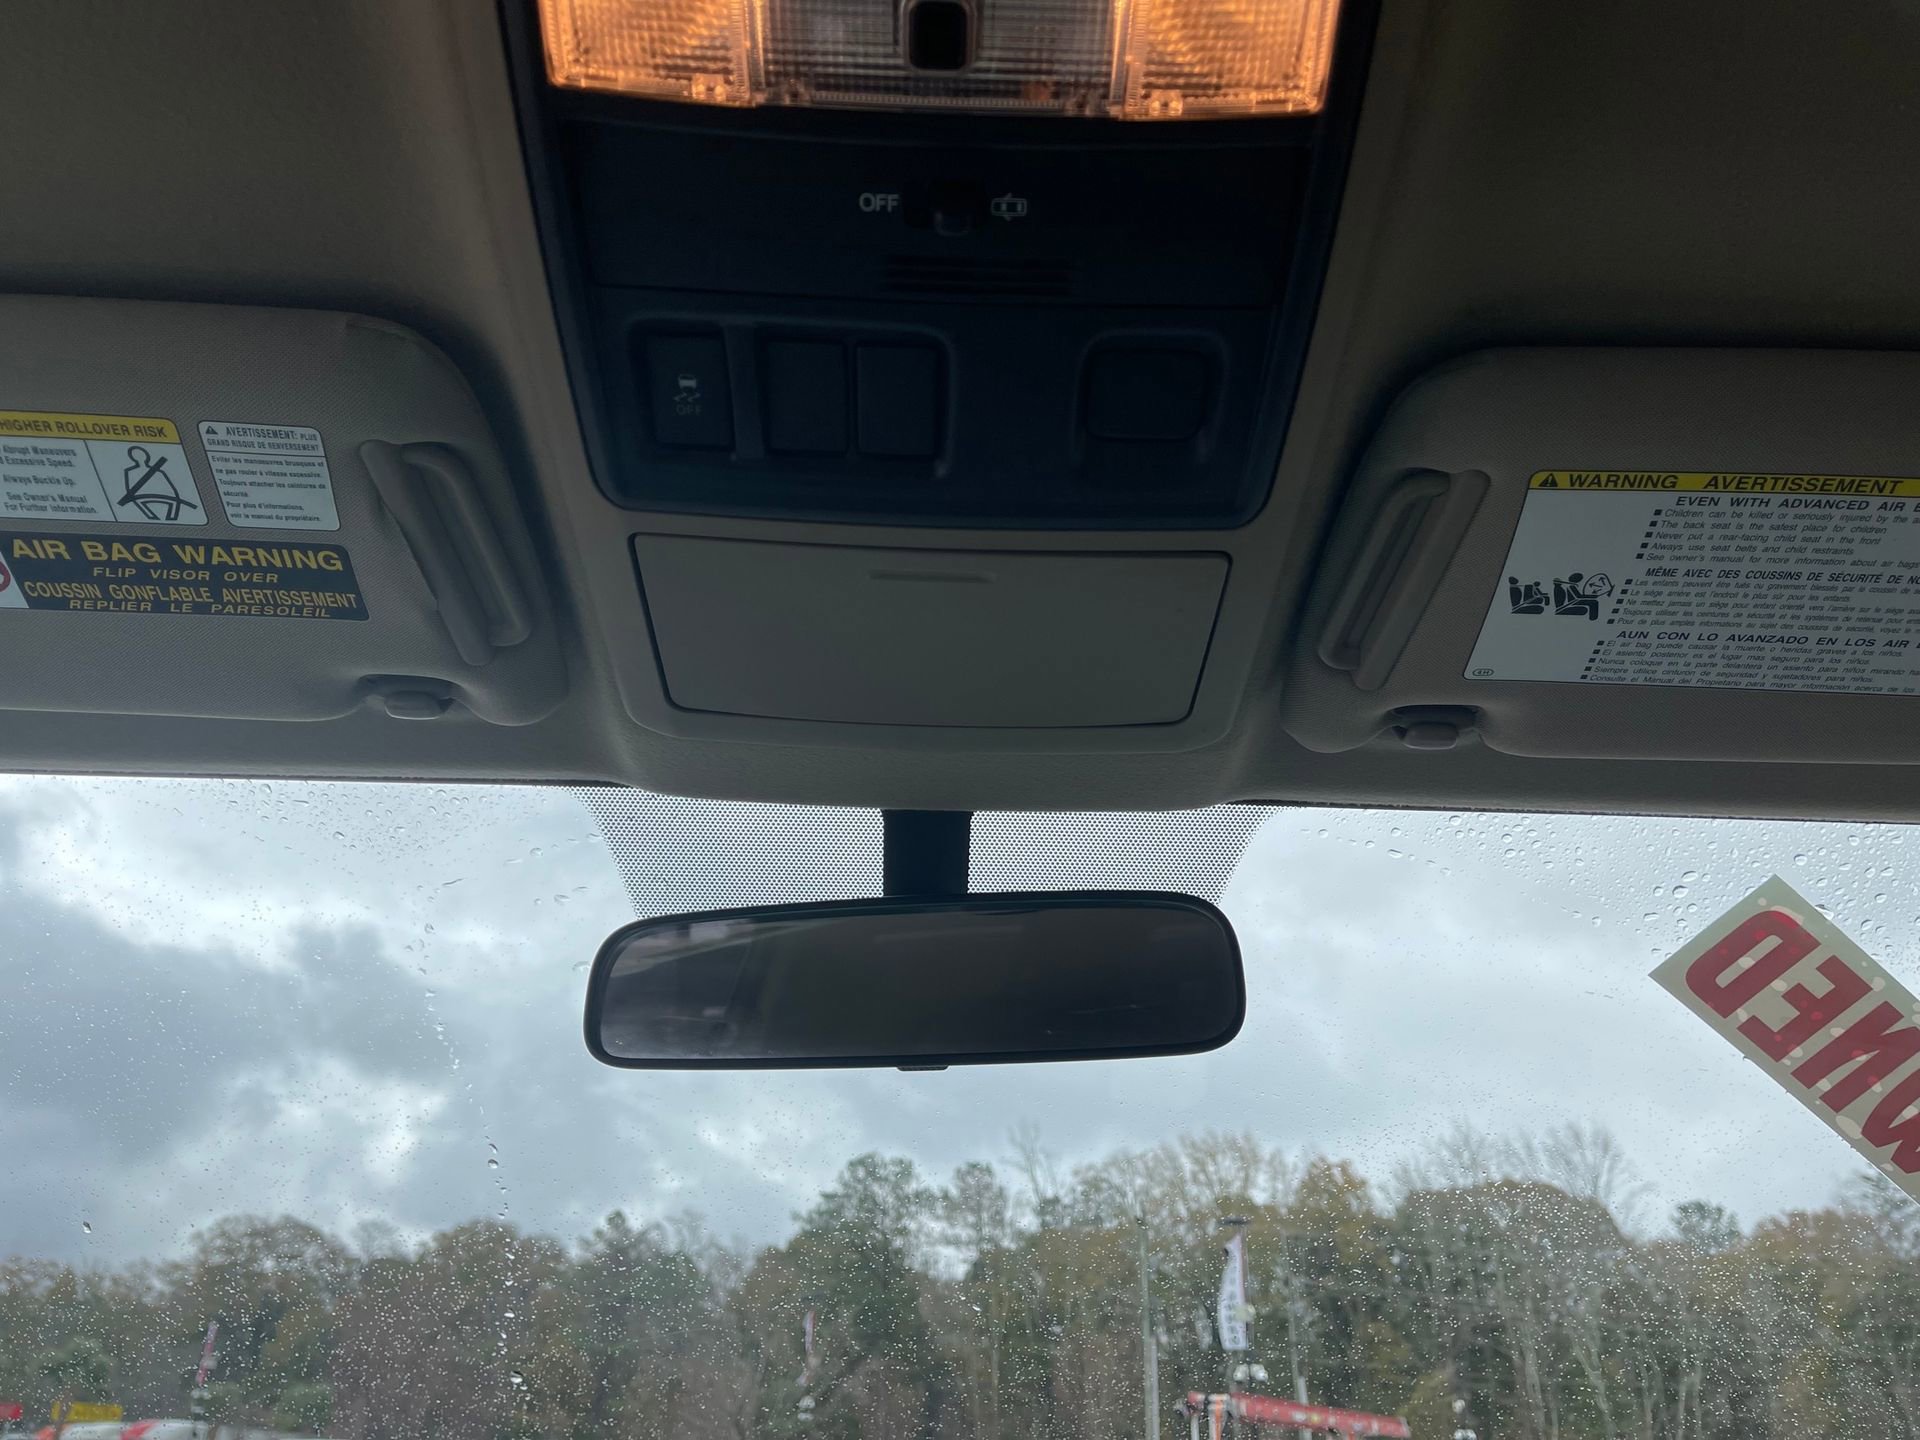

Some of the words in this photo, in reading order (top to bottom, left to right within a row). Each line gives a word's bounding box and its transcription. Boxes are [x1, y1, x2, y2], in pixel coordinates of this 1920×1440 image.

[859, 193, 899, 213] OFF
[676, 404, 703, 416] OFF
[0, 420, 52, 432] HIGHER
[57, 422, 130, 436] ROLLOVER
[134, 425, 167, 438] RISK
[226, 427, 298, 440] AVERTISSEMENT:
[207, 438, 229, 447] GRAND
[231, 440, 255, 449] RISQUE
[257, 441, 266, 449] DE
[268, 442, 319, 452] RENVERSEMENT
[1569, 474, 1679, 489] WARNING
[1703, 475, 1904, 494] AVERTISSEMENT
[1675, 496, 1721, 507] EVEN
[1730, 497, 1771, 508] WITH
[1778, 498, 1869, 511] ADVANCED
[1877, 501, 1906, 512] AIR
[1665, 508, 1704, 518] Children
[1708, 510, 1726, 518] can
[1731, 511, 1743, 519] be
[1748, 512, 1774, 520] killed
[1793, 512, 1834, 522] seriously
[1839, 513, 1872, 523] injured
[1876, 515, 1889, 524] by
[1893, 515, 1908, 524] the
[1660, 520, 1678, 529] The
[1683, 520, 1705, 529] back
[1710, 522, 1731, 530] seat
[1749, 523, 1764, 531] the
[1768, 523, 1798, 532] safest
[1801, 524, 1828, 533] place
[1850, 526, 1888, 534] children
[1655, 532, 1683, 540] Never
[1687, 533, 1703, 542] put
[1720, 534, 1769, 543] rear-facing
[1774, 535, 1796, 543] child
[1839, 536, 1854, 544] the
[1858, 537, 1881, 545] front
[13, 539, 71, 560] AIR
[81, 541, 162, 563] BAG
[172, 544, 343, 571] WARNING
[1650, 543, 1683, 552] Always
[1688, 544, 1705, 552] use
[1709, 544, 1731, 552] seat
[1735, 544, 1757, 553] belts
[1762, 545, 1780, 554] and
[1785, 545, 1807, 554] child
[1811, 547, 1855, 555] restraints
[1646, 553, 1665, 561] See
[1669, 554, 1705, 562] owner's
[1710, 555, 1744, 563] manual
[1749, 555, 1762, 563] for
[1795, 557, 1846, 567] information
[1850, 559, 1877, 567] about
[1881, 560, 1894, 568] air
[93, 567, 137, 578] FLIP
[150, 568, 210, 581] VISOR
[223, 572, 279, 583] OVER
[1645, 566, 1679, 577] MÊME
[1682, 569, 1713, 578] AVEC
[1717, 570, 1741, 579] DES
[1745, 570, 1803, 580] COUSSINS
[1806, 572, 1824, 581] DE
[1828, 572, 1884, 583] SÉCURITÉ
[1886, 574, 1904, 584] DE
[24, 582, 101, 599] COUSSIN
[109, 584, 211, 603] GONFLABLE
[222, 587, 357, 609] AVERTISSEMENT
[70, 600, 152, 612] REPLIER
[171, 602, 193, 613] LE
[211, 604, 331, 618] PARESOLEIL
[1617, 631, 1650, 639] AUN
[1657, 632, 1690, 640] CON
[1697, 633, 1719, 641] LO
[1725, 634, 1809, 645] AVANZADO
[1816, 637, 1838, 646] EN
[1844, 638, 1877, 647] LOS
[1882, 640, 1910, 648] AIR
